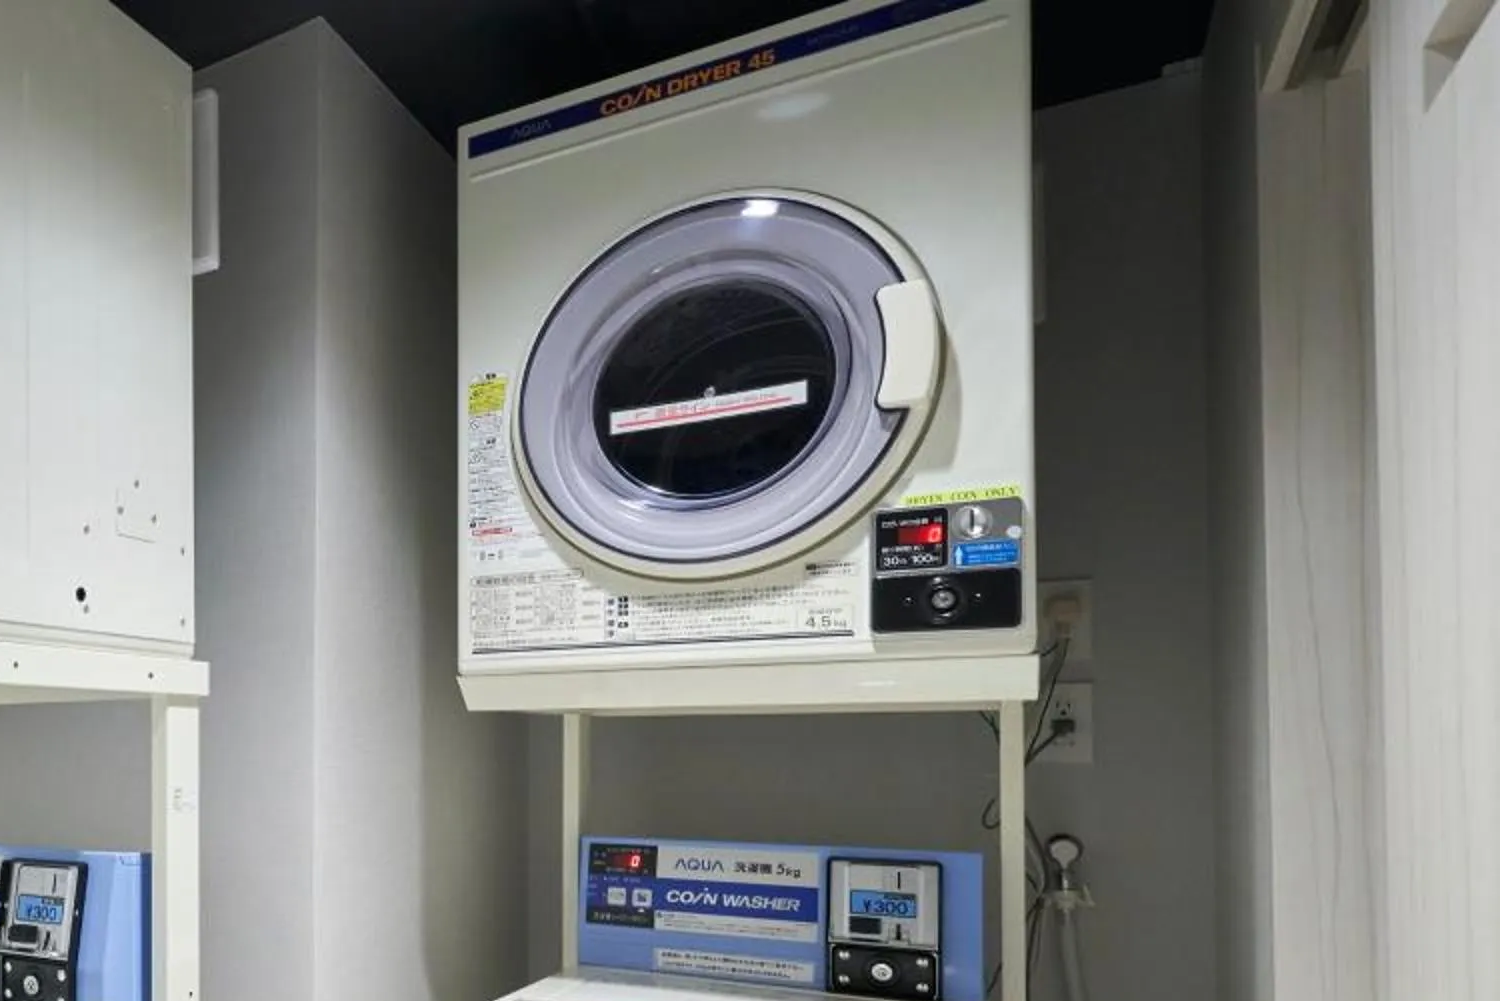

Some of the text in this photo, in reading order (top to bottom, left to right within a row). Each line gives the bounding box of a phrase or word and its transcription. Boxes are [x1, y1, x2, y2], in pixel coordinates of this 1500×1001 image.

[666, 60, 741, 94] DRYER
[747, 48, 775, 70] 45
[631, 855, 640, 868] 0
[674, 857, 726, 873] AQUA
[722, 893, 802, 913] WASHER
[862, 898, 910, 915] ¥300
